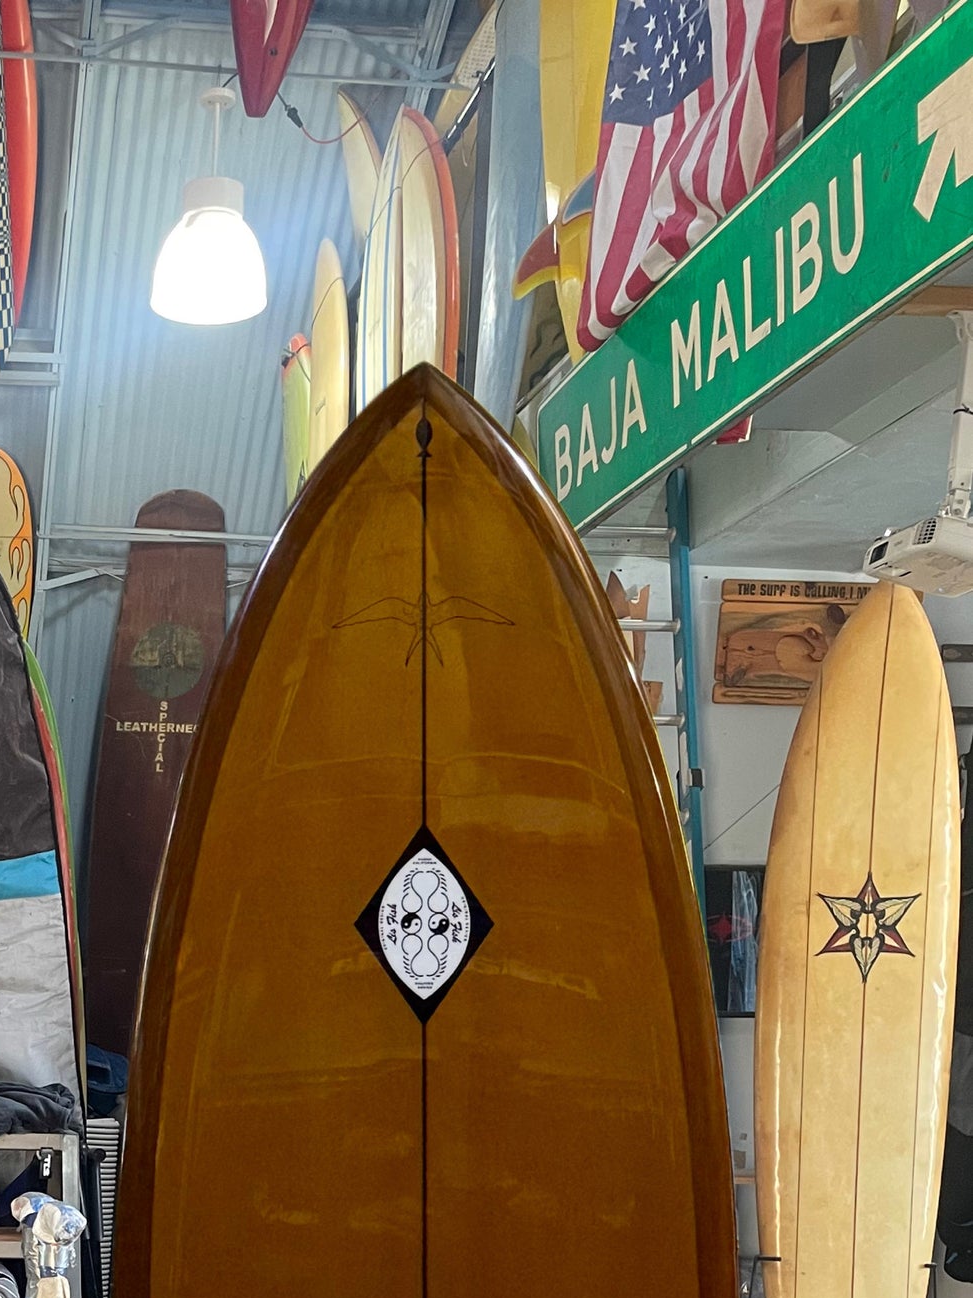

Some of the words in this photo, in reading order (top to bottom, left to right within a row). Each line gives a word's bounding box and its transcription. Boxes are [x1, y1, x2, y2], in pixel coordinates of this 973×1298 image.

[554, 358, 647, 503] BAJA
[671, 152, 866, 409] MALIBU
[790, 585, 800, 597] IS
[115, 721, 197, 734] LEATHERNE
[154, 700, 169, 773] SPECIAL
[386, 903, 399, 926] Fish
[450, 921, 463, 943] Fish
